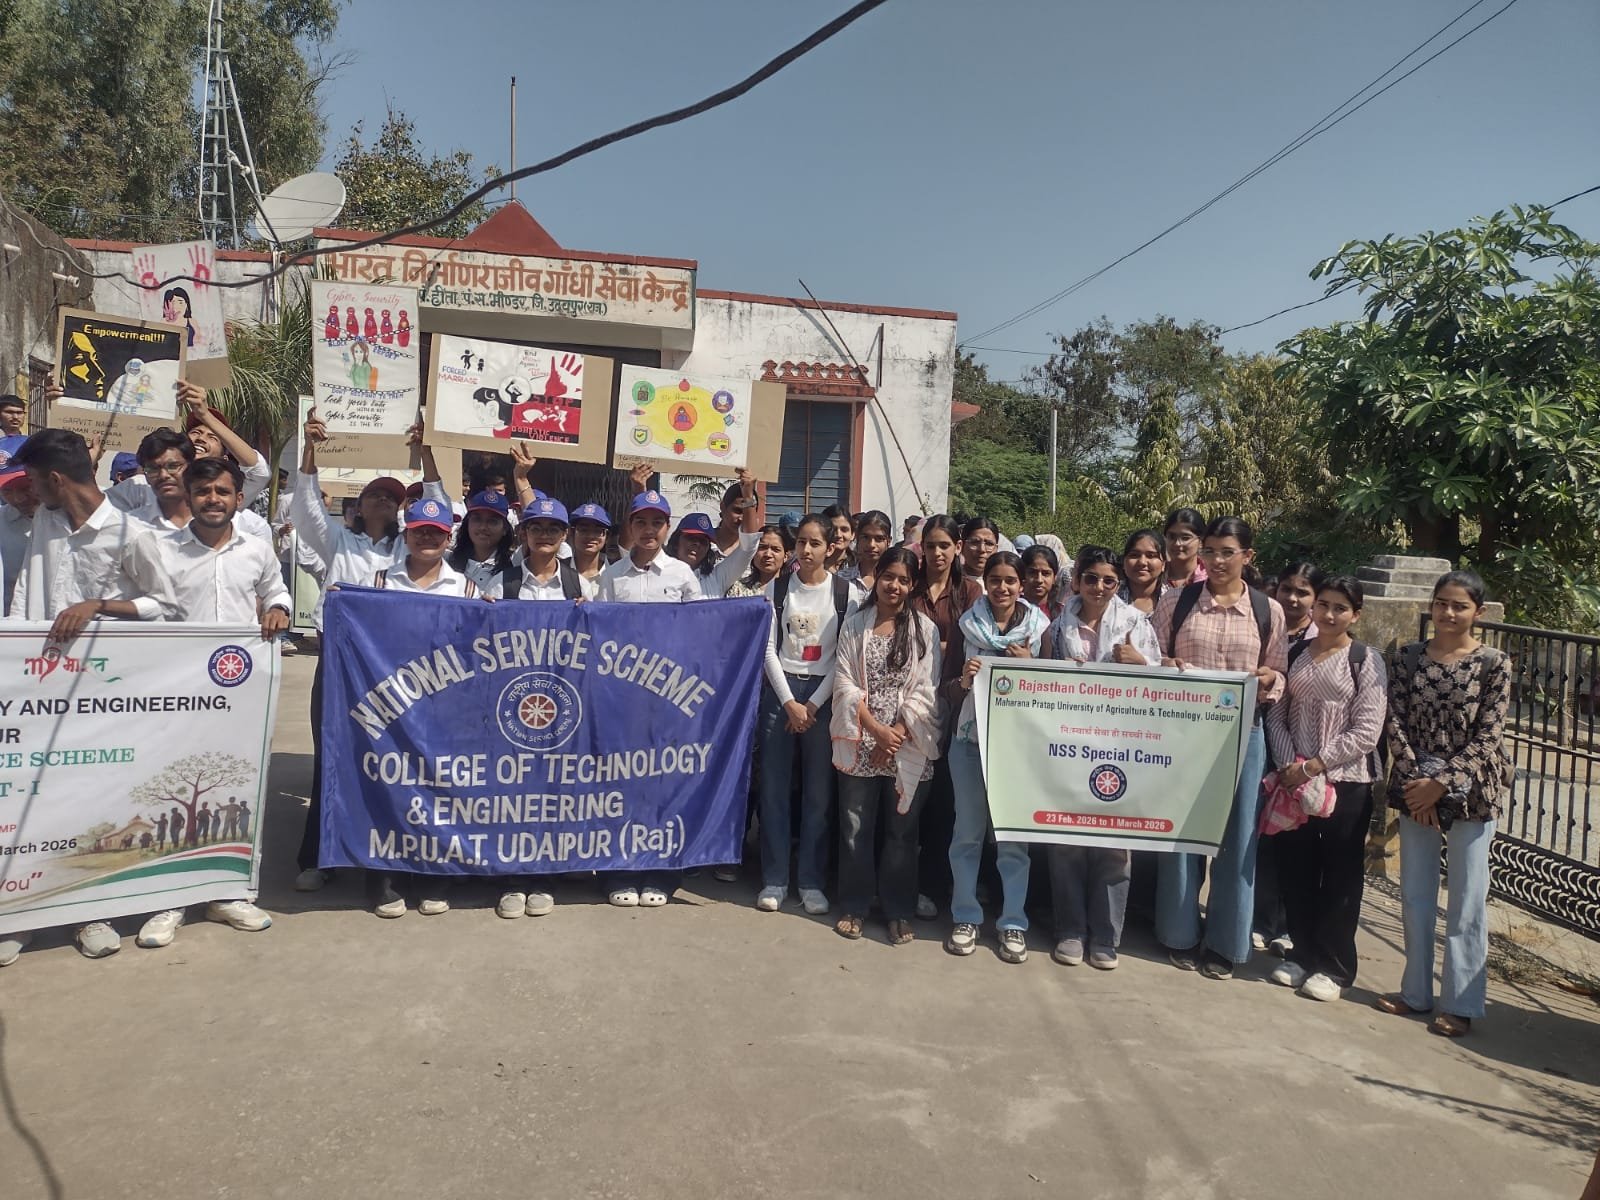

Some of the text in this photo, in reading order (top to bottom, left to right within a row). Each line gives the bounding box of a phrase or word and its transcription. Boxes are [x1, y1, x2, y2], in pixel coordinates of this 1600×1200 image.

[331, 252, 396, 280] भारत
[595, 266, 642, 302] सेवा
[442, 365, 467, 376] FORCED
[346, 411, 382, 422] Security
[349, 628, 716, 740] NATIONAL SERVICE SCHEME
[532, 677, 553, 689] सेवा
[1018, 679, 1212, 704] Rajasthan College of Agriculture
[19, 698, 70, 716] AND
[77, 695, 232, 714] ENGINEERING,
[995, 697, 1030, 708] Maharana
[1032, 699, 1056, 712] Pratap
[1057, 700, 1094, 714] University
[1096, 703, 1103, 713] of
[1105, 703, 1147, 716] Agriculture
[1149, 707, 1155, 717] &
[1205, 711, 1235, 724] Udaipur
[30, 748, 135, 767] SCHEME
[363, 742, 714, 788] COLLEGE OF TECHNOLOGY
[1049, 743, 1172, 768] NSS Special Camp
[406, 790, 624, 826] & ENGINEERING
[1045, 813, 1165, 830] 23 Feb. 2026 to 1 March 2026
[0, 838, 77, 856] arch 2026
[369, 814, 686, 866] M.P.U.A.T. UDAIPUR (Raj.)
